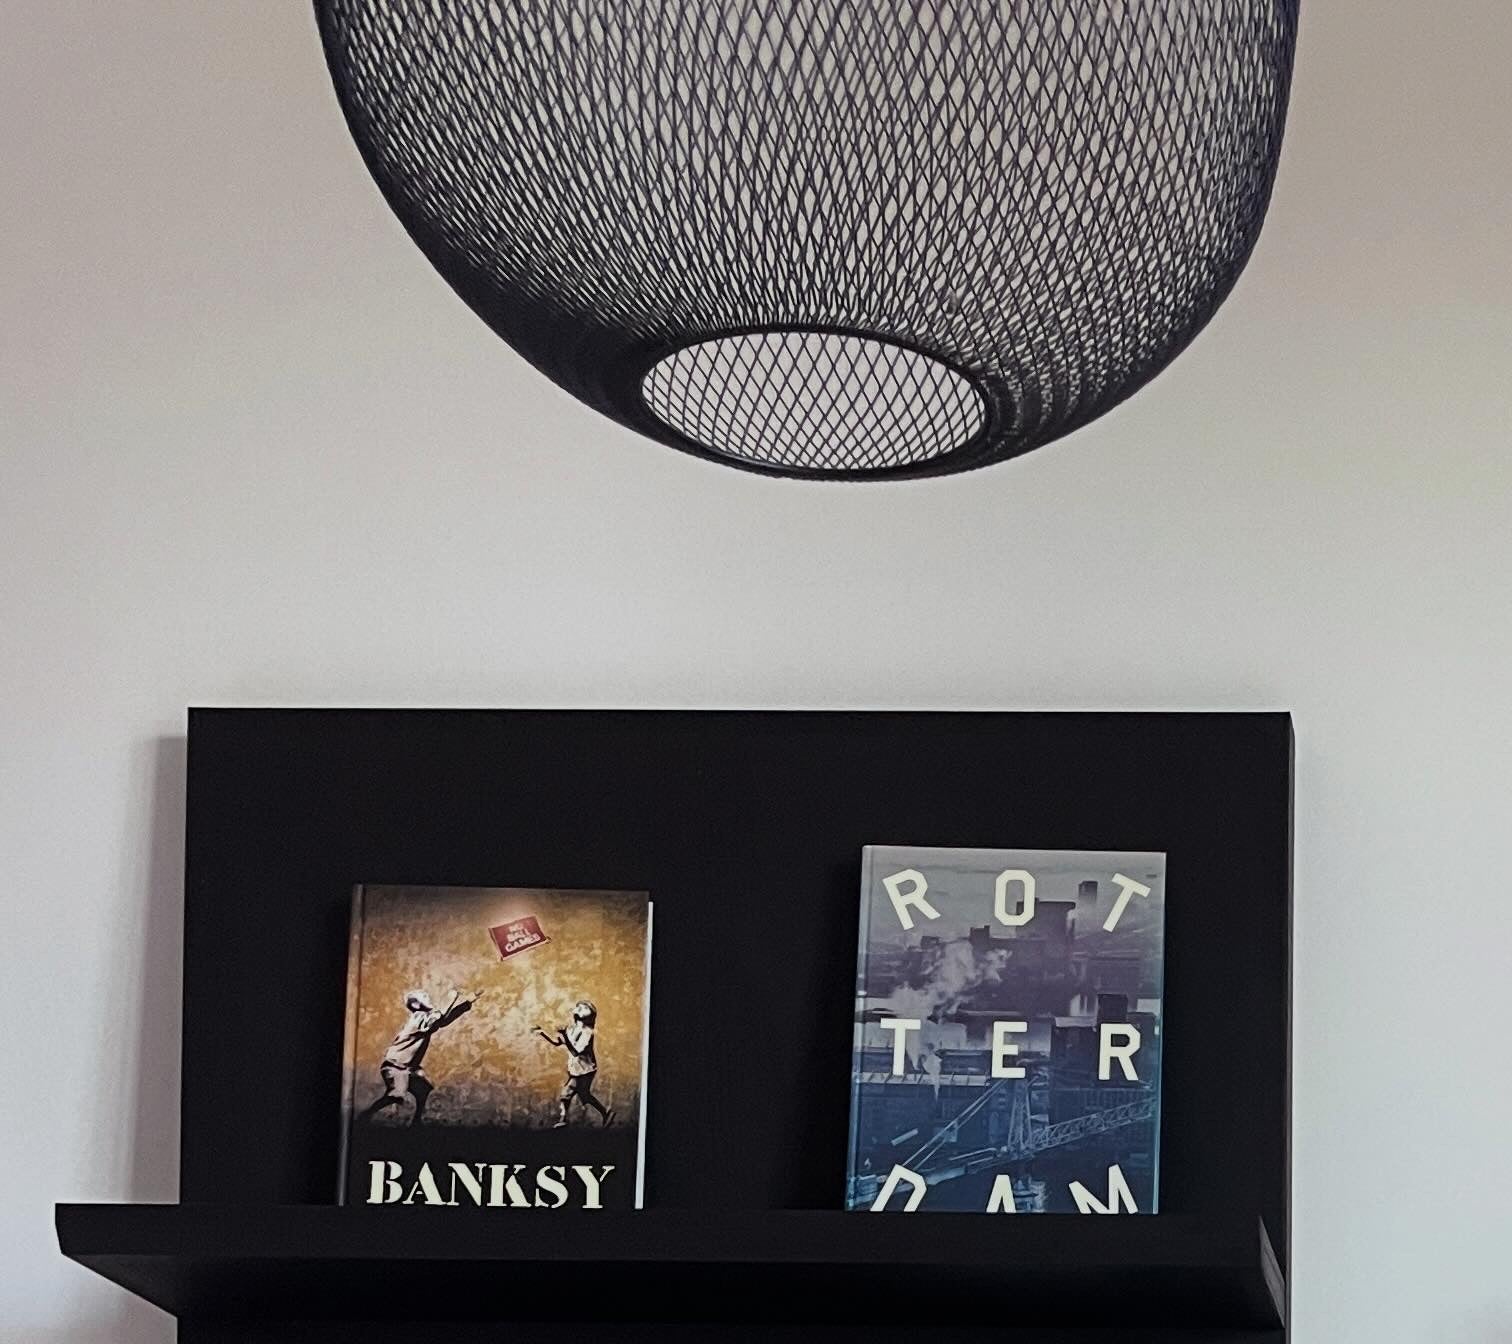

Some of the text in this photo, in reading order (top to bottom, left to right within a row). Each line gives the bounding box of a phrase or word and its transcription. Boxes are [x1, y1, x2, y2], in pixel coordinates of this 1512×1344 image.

[881, 868, 1152, 932] ROT
[880, 1018, 1141, 1081] TER
[366, 1160, 616, 1209] BANKSY
